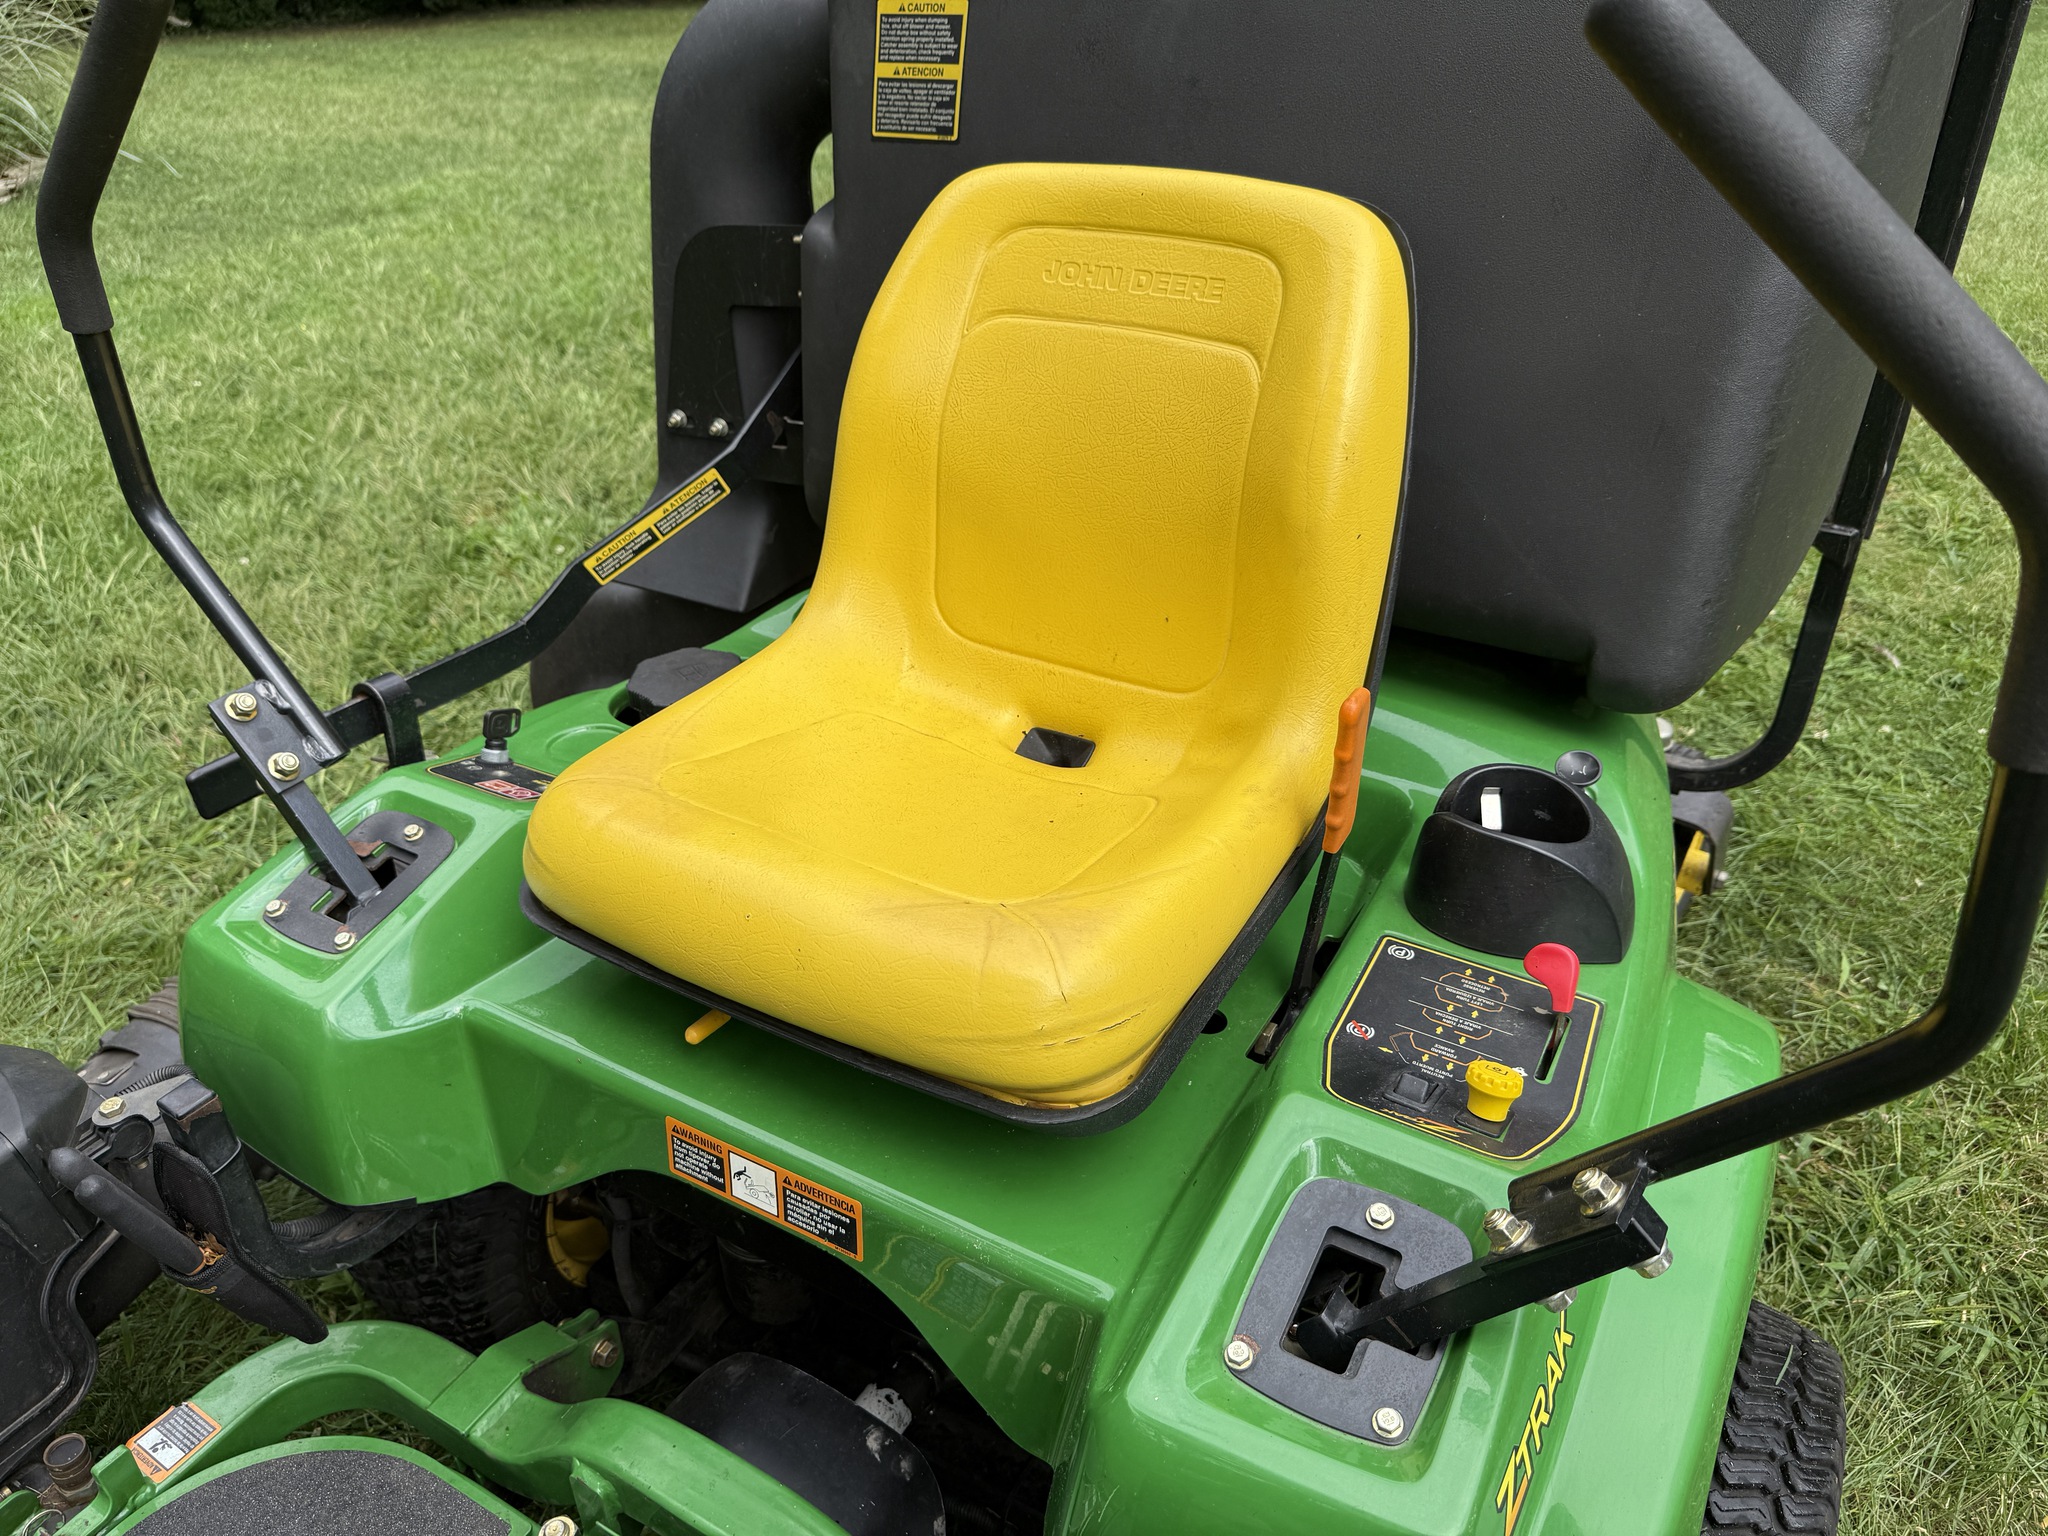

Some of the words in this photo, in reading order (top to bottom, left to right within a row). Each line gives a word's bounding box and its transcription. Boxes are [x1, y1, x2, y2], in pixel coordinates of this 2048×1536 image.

[907, 3, 946, 12] CAUTION
[902, 67, 944, 77] ATENCION
[1042, 260, 1123, 291] JOHN
[1128, 269, 1226, 303] DEERE
[669, 478, 708, 508] ATENCION
[602, 529, 636, 557] CAUTION
[1460, 978, 1491, 990] RETROCESO
[1462, 983, 1485, 993] REVERSE
[1455, 994, 1470, 1002] TURN
[1434, 1010, 1458, 1021] DERECHA
[1441, 1017, 1456, 1025] TURN
[1463, 1020, 1482, 1029] VIRAJE
[1456, 1022, 1473, 1031] RIGHT
[1430, 1046, 1457, 1059] FORWARD
[1433, 1042, 1455, 1053] AVANCE
[1411, 1059, 1433, 1070] MUERTO
[1419, 1067, 1445, 1079] NEUTRAL
[1434, 1067, 1453, 1077] PUNTO
[672, 1136, 680, 1145] To
[681, 1140, 697, 1153] avoid
[698, 1149, 716, 1163] injury
[680, 1126, 722, 1154] WARNING
[673, 1142, 687, 1154] from
[688, 1150, 711, 1166] tipover,
[711, 1161, 720, 1170] do
[674, 1149, 684, 1159] not
[685, 1154, 708, 1170] operate
[674, 1155, 699, 1172] machine
[700, 1167, 724, 1183] without
[675, 1161, 708, 1182] attachment
[786, 1189, 800, 1201] Para
[802, 1196, 820, 1210] evitar
[822, 1205, 850, 1223] lesiones
[794, 1180, 856, 1215] ADVERTENCIA
[786, 1195, 817, 1214] causadas
[819, 1211, 830, 1221] por
[786, 1202, 811, 1219] arrollar,
[813, 1214, 821, 1223] no
[823, 1219, 837, 1230] usar
[839, 1225, 845, 1234] la
[787, 1208, 815, 1227] máquina
[816, 1222, 826, 1232] sin
[828, 1227, 834, 1236] el
[787, 1215, 819, 1235] accesorio
[1495, 1309, 1575, 1536] ZTRAK
